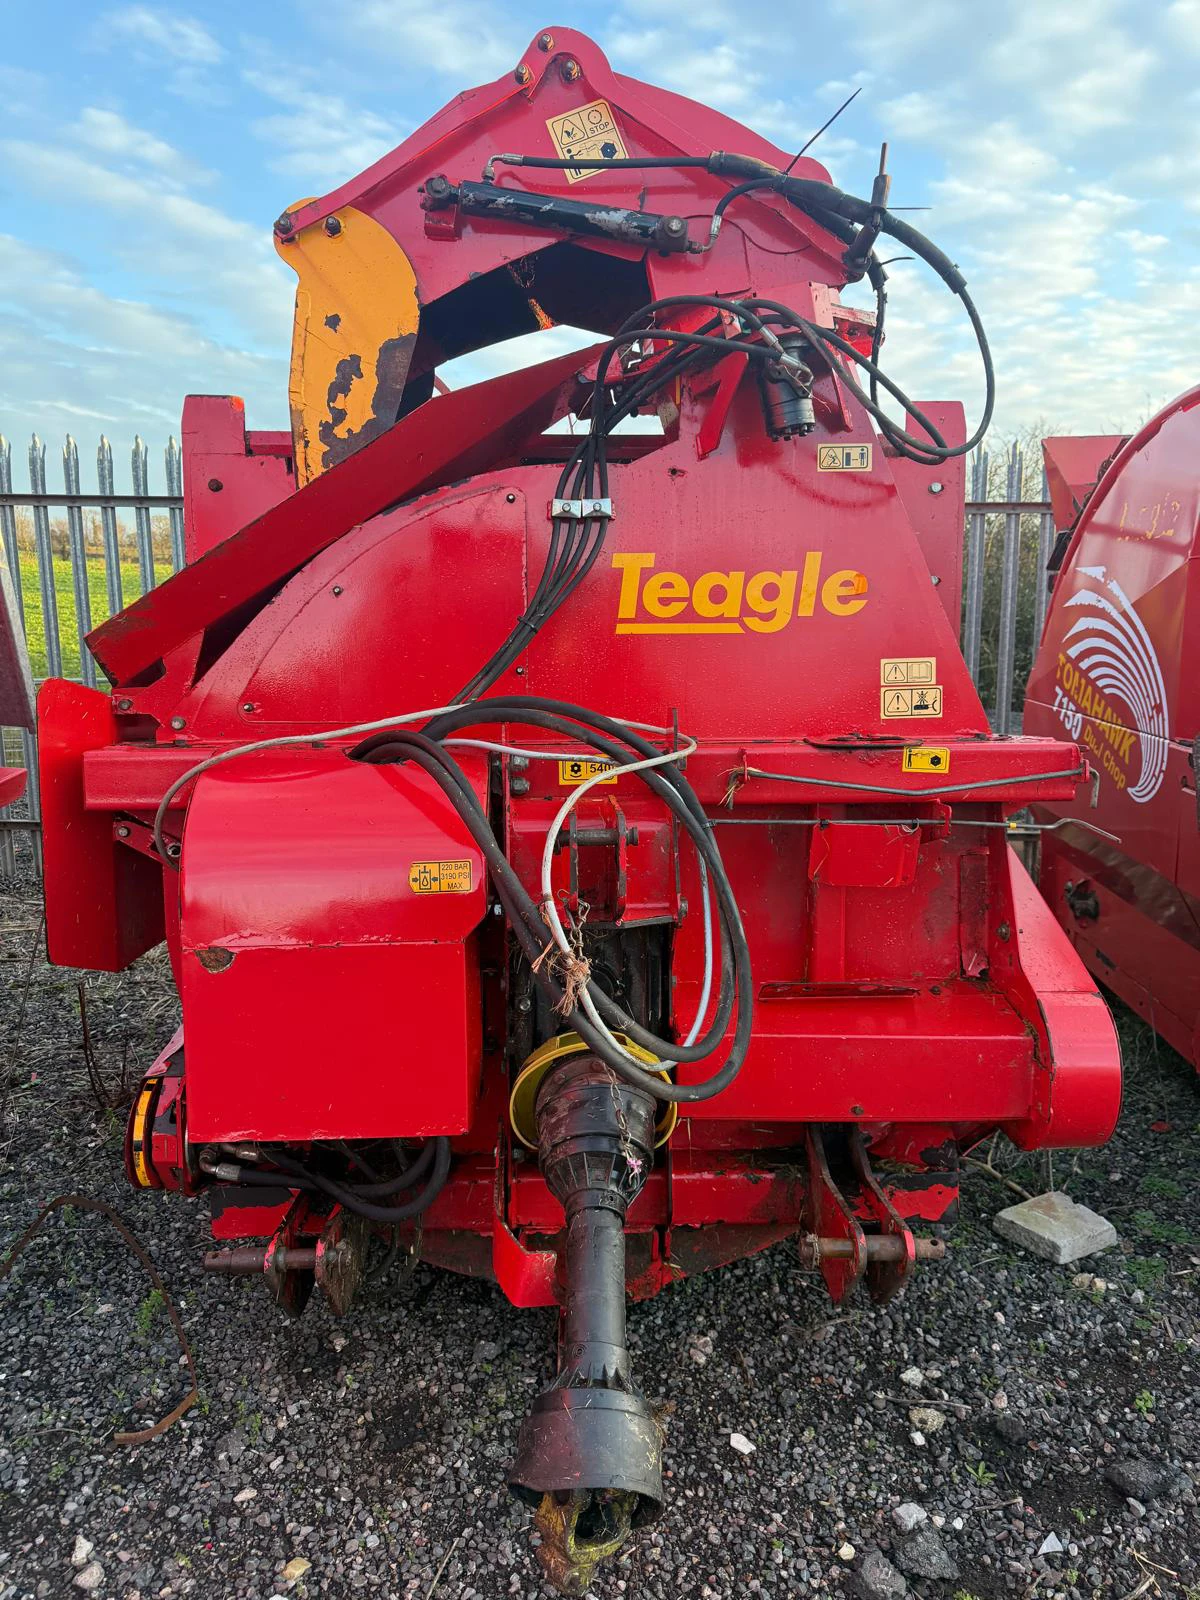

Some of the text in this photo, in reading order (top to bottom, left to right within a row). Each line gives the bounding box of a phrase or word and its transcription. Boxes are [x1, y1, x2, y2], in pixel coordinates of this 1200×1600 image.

[589, 122, 610, 134] STOP
[611, 551, 869, 634] Teagle
[1052, 686, 1083, 740] 7150
[1056, 652, 1137, 765] TOMAHAWK
[1103, 750, 1126, 790] Chop
